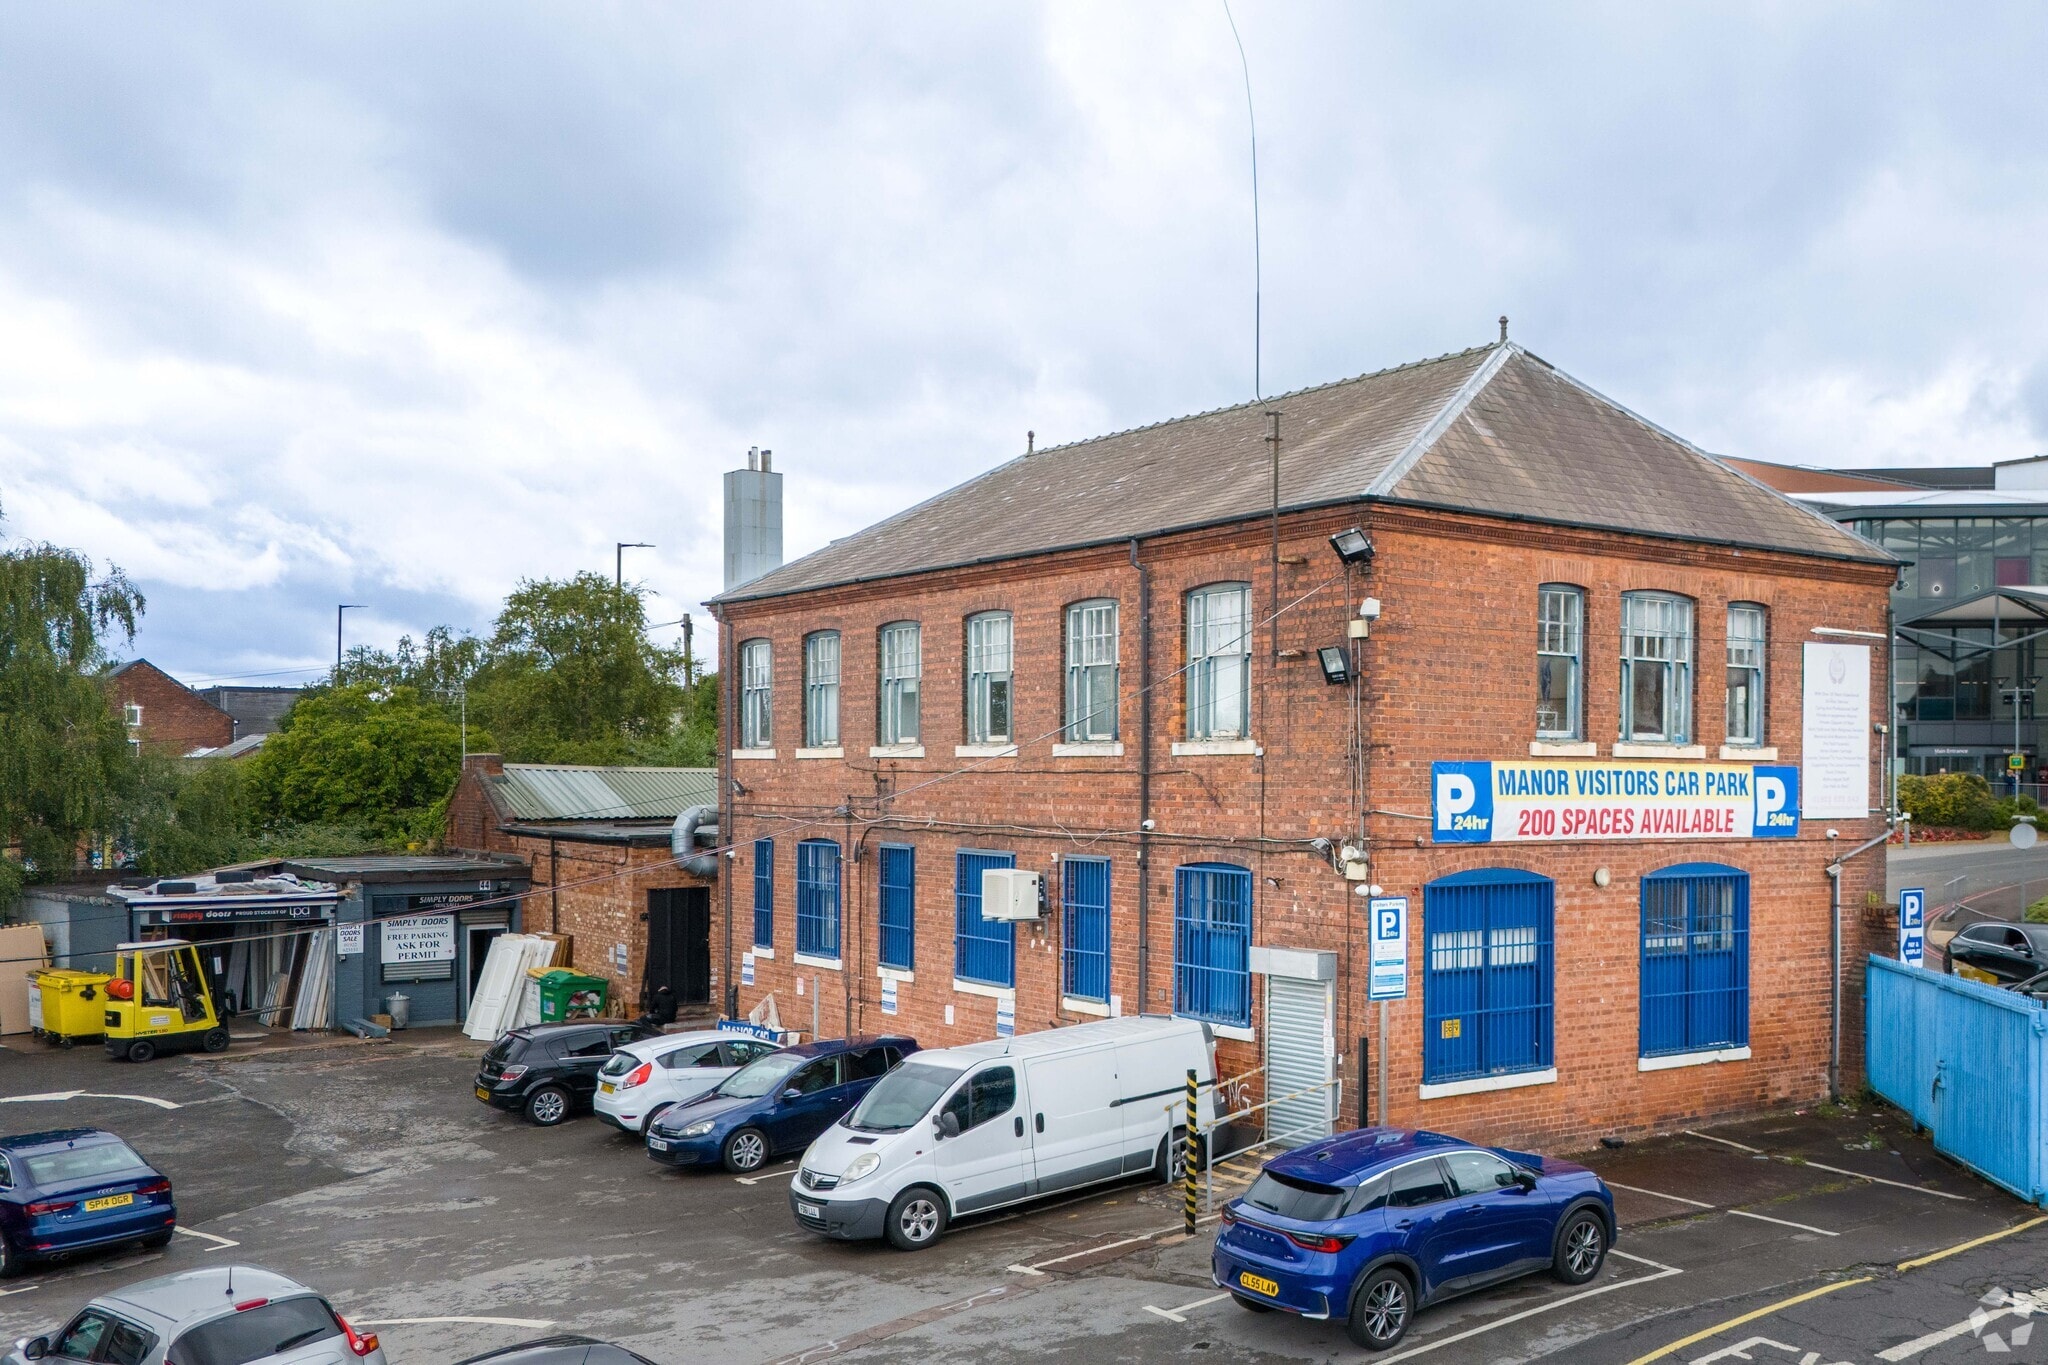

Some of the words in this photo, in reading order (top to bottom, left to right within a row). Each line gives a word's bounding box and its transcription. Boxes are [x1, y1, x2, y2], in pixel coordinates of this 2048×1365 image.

[1498, 769, 1569, 796] MANOR
[1575, 770, 1658, 796] VISITORS
[1665, 771, 1699, 796] CAR
[1706, 772, 1749, 796] PARK
[1437, 774, 1475, 830] P
[1755, 776, 1786, 827] P
[1454, 815, 1489, 830] 24hr
[1518, 808, 1555, 836] 200
[1562, 807, 1634, 835] SPACES
[1640, 808, 1734, 833] AVAILABLE
[1769, 813, 1795, 827] 24hr
[172, 911, 203, 920] simply
[205, 910, 231, 918] doors
[1905, 896, 1919, 926] P
[387, 919, 417, 927] SIMPLY
[1381, 911, 1396, 938] P
[396, 942, 416, 950] ASK
[419, 940, 440, 948] FOR
[398, 951, 438, 960] PERMIT
[88, 1198, 109, 1209] SP14
[111, 1195, 129, 1205] OGR
[1242, 1274, 1261, 1289] CL55
